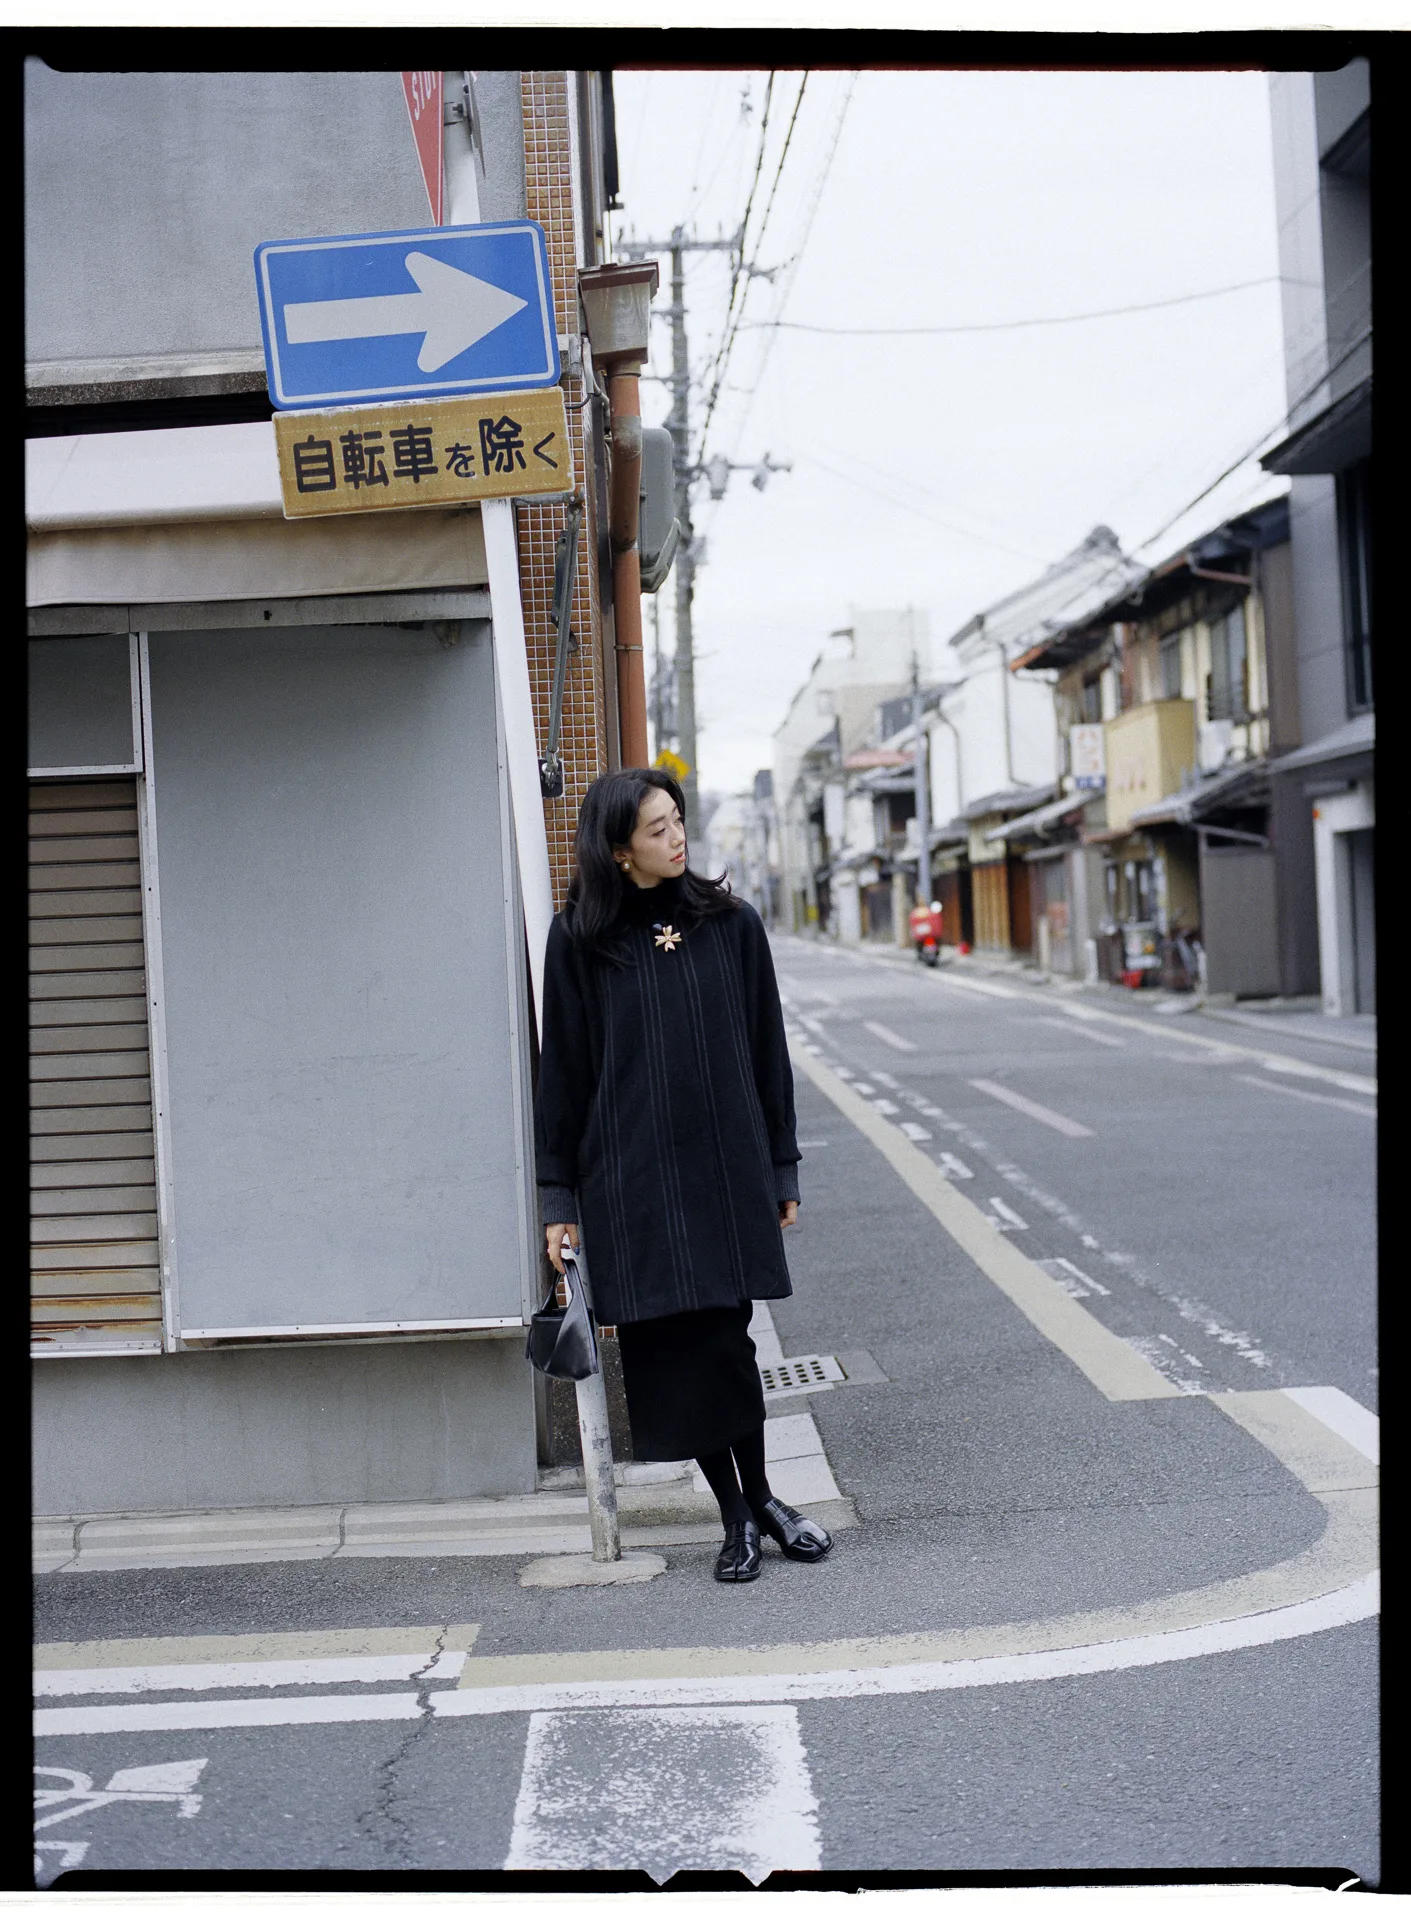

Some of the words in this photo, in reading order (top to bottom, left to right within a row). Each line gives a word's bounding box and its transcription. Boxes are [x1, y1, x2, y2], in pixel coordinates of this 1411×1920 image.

[293, 416, 558, 493] 自転車を除く
